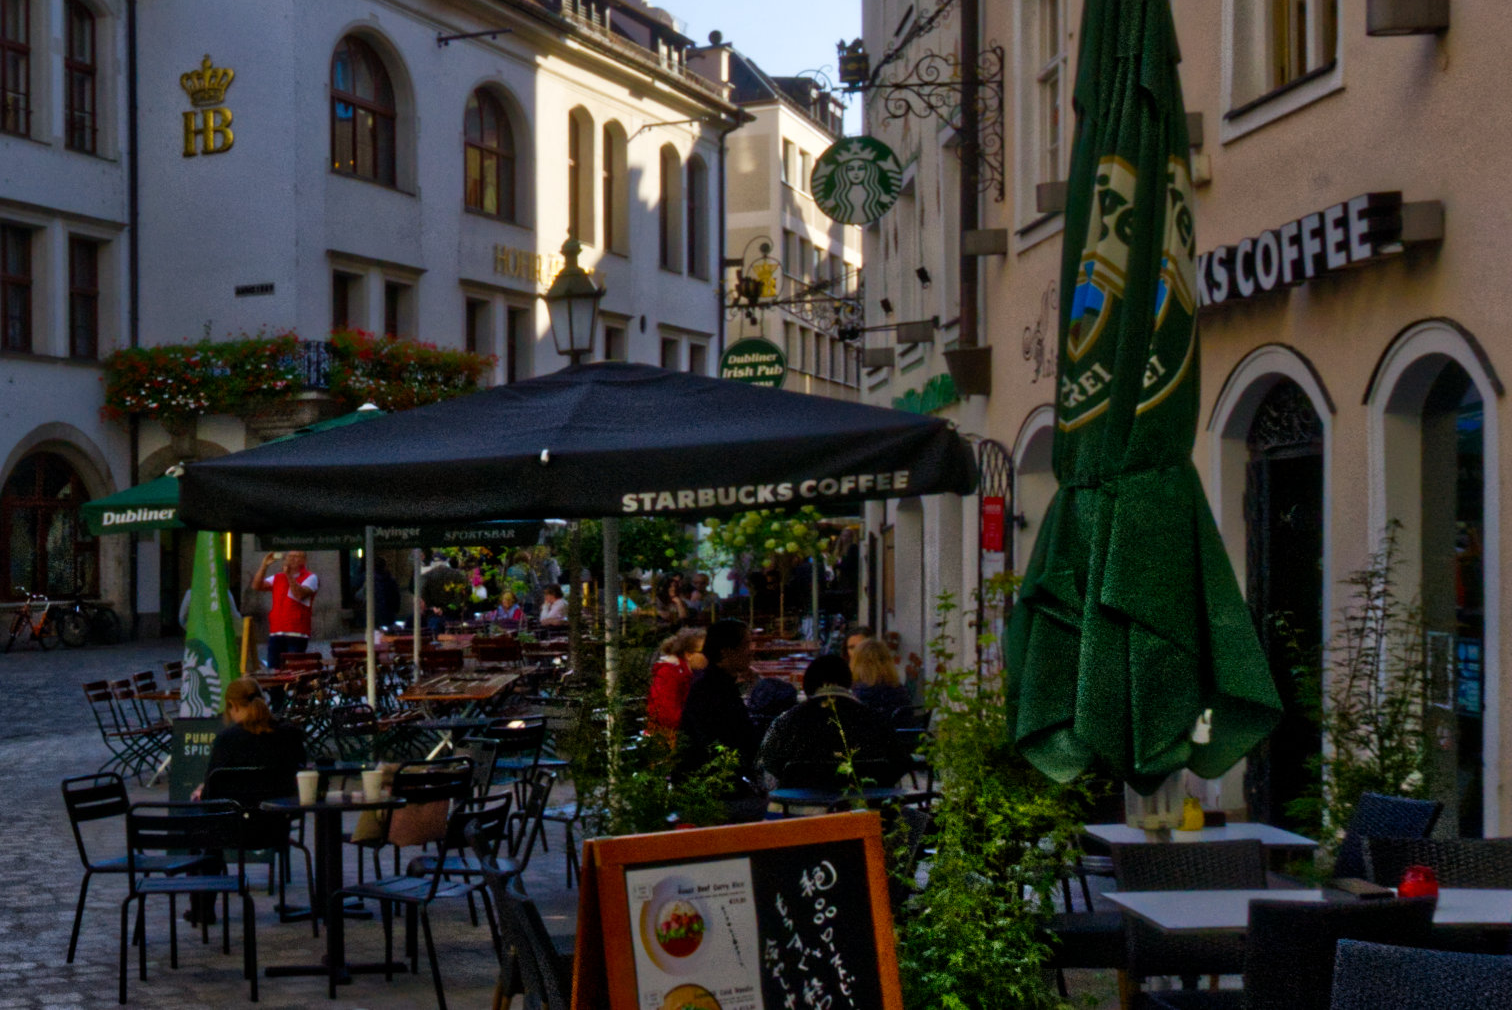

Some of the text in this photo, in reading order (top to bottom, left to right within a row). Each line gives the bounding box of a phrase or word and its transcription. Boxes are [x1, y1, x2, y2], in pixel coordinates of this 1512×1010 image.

[182, 107, 235, 159] HB
[1196, 246, 1230, 307] KS
[1235, 193, 1372, 298] COFFEE
[727, 353, 778, 365] Dubliner
[722, 363, 785, 379] Irish Pub
[621, 470, 910, 513] STARBUCKS COFFEE
[102, 508, 176, 526] Dubliner
[444, 529, 516, 541] SPORTSBAR
[184, 732, 216, 744] PUMP
[184, 744, 210, 756] SPIC
